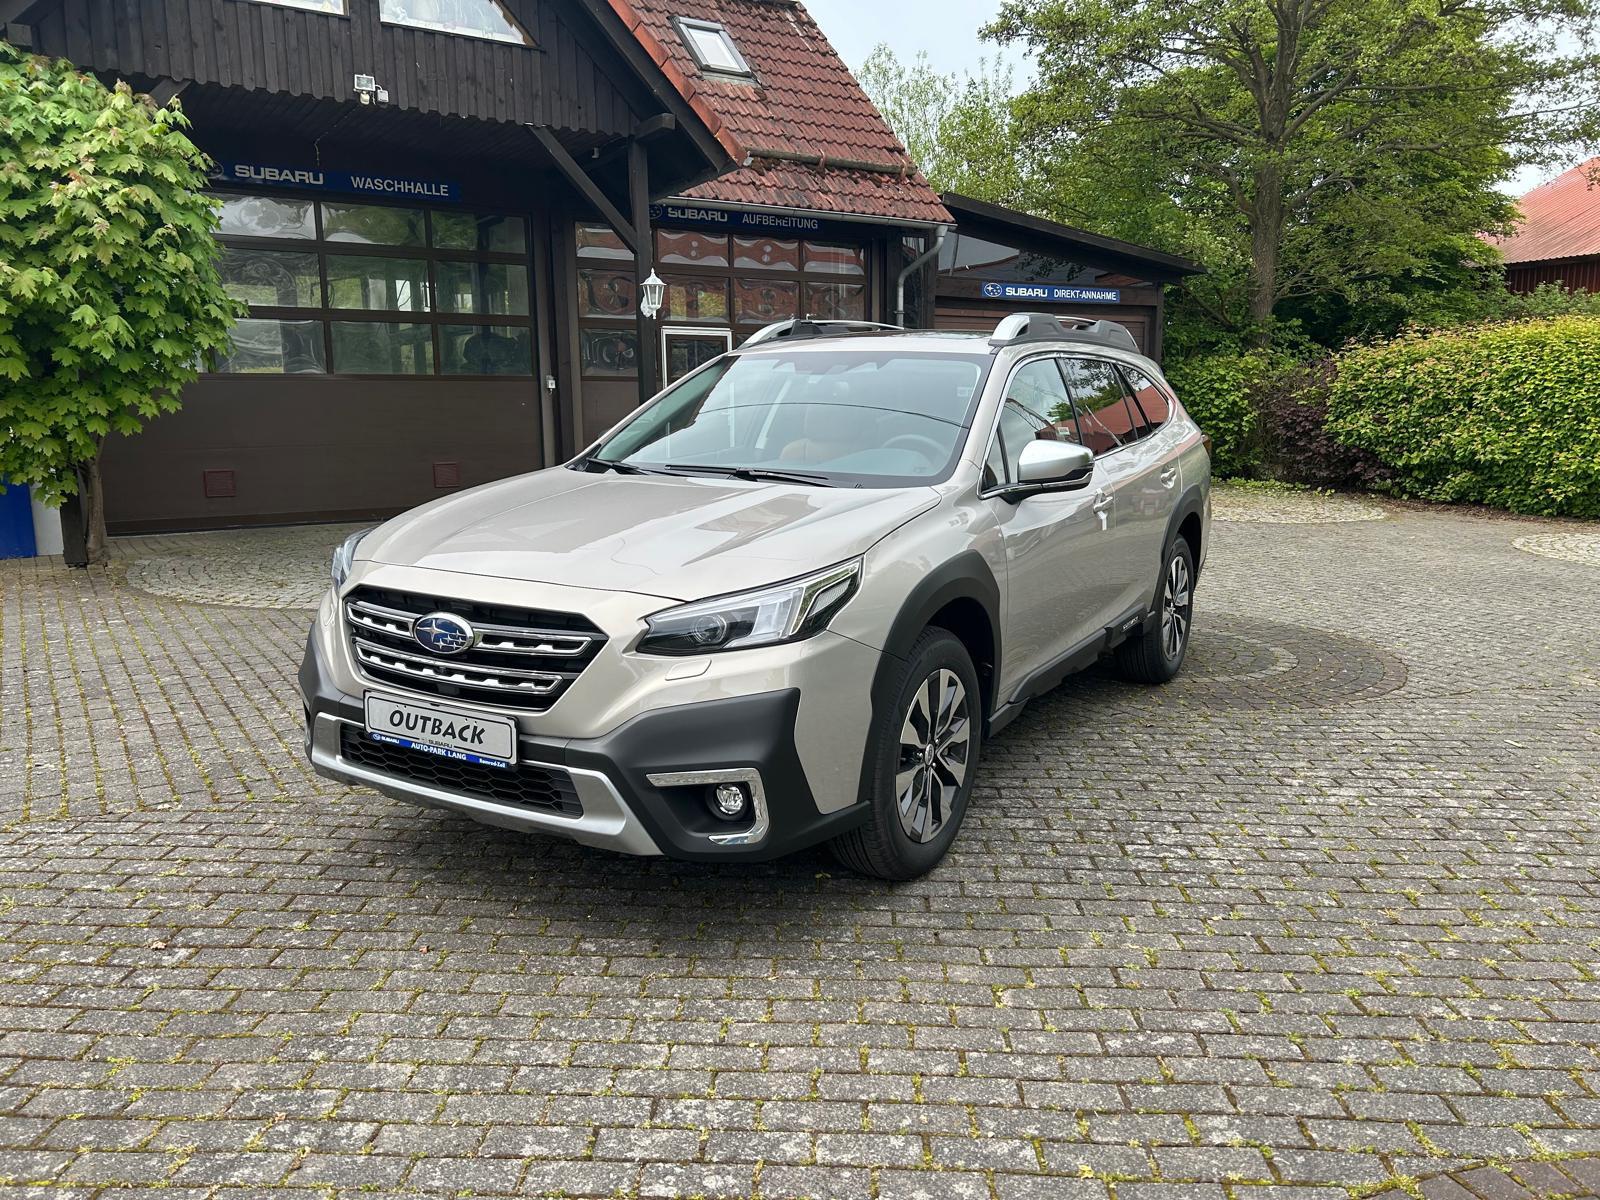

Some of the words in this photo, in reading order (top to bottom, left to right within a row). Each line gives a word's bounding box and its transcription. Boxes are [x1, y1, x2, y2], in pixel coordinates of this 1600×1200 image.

[234, 164, 324, 185] SUBARU
[350, 175, 449, 196] WASCHHALLE
[667, 207, 728, 222] SUBARU
[742, 213, 819, 229] AUFBEREITUNG
[1005, 287, 1048, 297] SUBARU
[1053, 289, 1117, 300] DIREKT-ANNAHME
[389, 709, 486, 745] OUTBACK
[410, 742, 447, 757] AUTO-PARK
[447, 750, 467, 760] LANG
